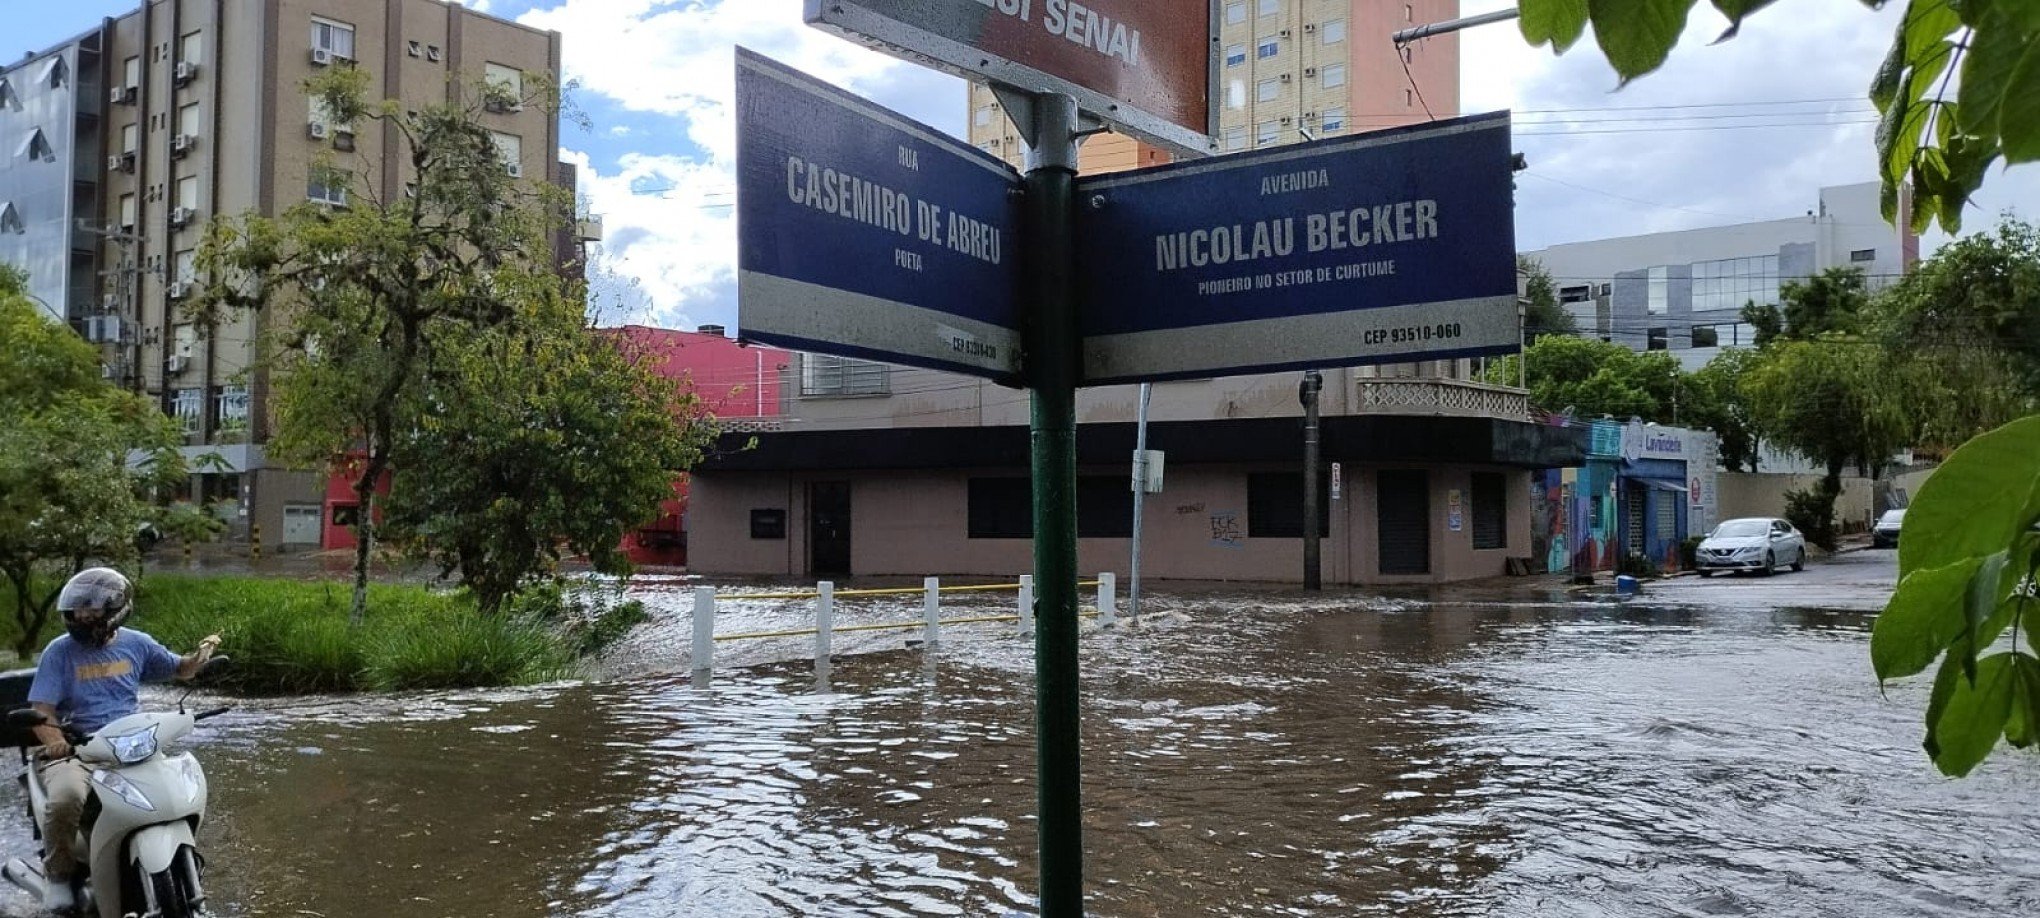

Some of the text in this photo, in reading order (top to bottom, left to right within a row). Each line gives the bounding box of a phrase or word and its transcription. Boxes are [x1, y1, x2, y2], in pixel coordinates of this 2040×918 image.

[1043, 0, 1141, 65] SENAI
[898, 145, 919, 172] RUA
[1261, 168, 1330, 196] AVENIDA
[788, 156, 1001, 265] CASEMIRO DE ABREU
[1155, 199, 1438, 272] NICOLAU BECKER
[895, 248, 923, 273] POETA
[1198, 259, 1397, 296] PIONEIRO NO SETOR DE CURTUME
[1363, 322, 1462, 345] CEP 93510-060
